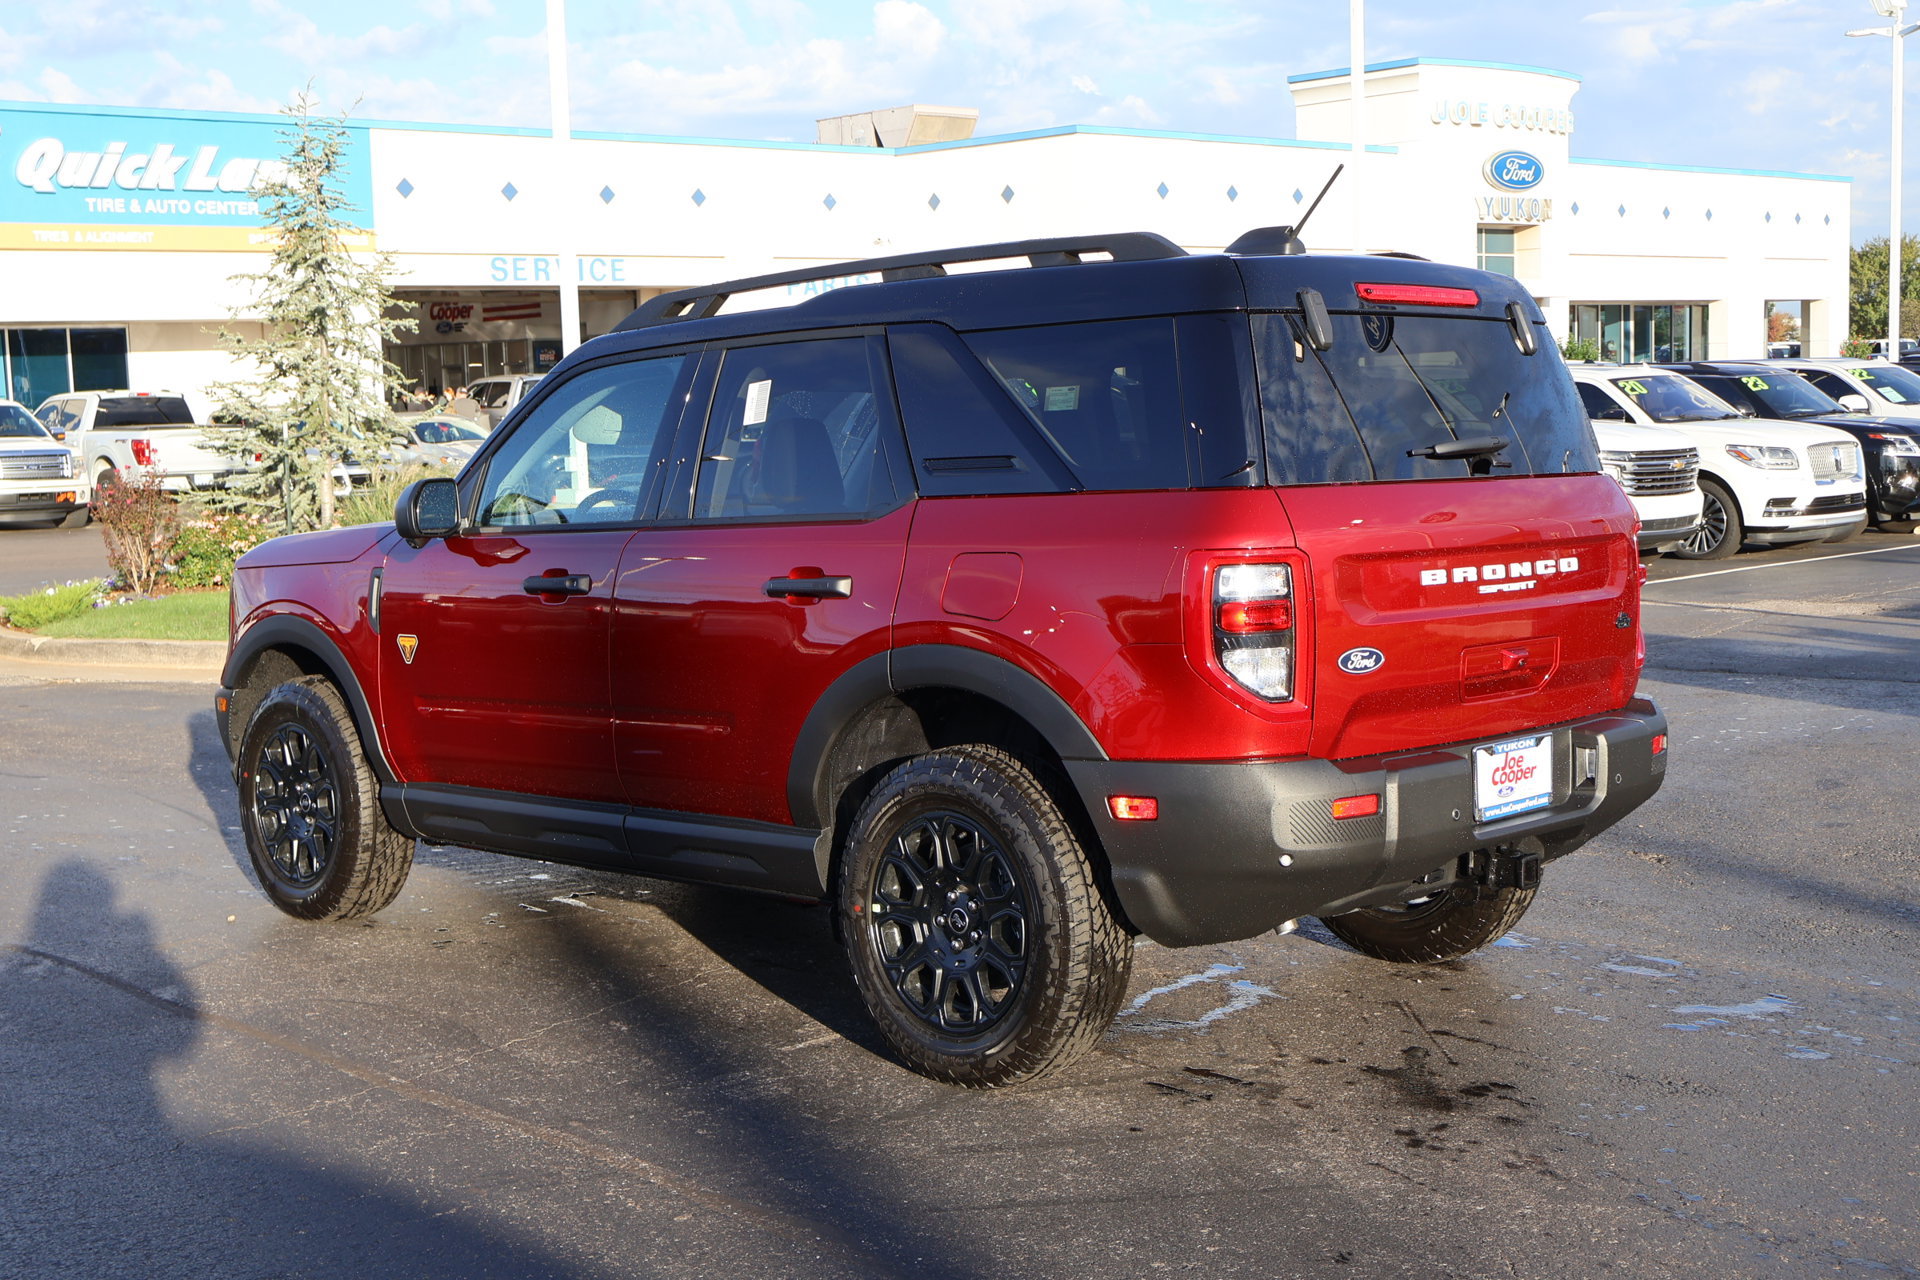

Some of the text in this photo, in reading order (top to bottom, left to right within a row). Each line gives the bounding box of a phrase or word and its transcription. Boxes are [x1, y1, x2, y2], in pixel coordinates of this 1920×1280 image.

[15, 137, 190, 194] Quick
[1502, 157, 1536, 182] Ford
[85, 198, 259, 216] TIRE & AUTO CENTER
[1475, 196, 1552, 222] YUKON
[490, 256, 626, 282] SERICE
[430, 302, 475, 322] Cooper
[1618, 380, 1649, 395] 20
[1741, 376, 1770, 391] 23
[1420, 557, 1579, 586] BRONCO
[1478, 579, 1538, 594] SPORT
[1347, 651, 1377, 669] Ford
[1497, 738, 1536, 751] YUKON
[1501, 752, 1524, 771] Joe
[1491, 765, 1537, 785] Cooper
